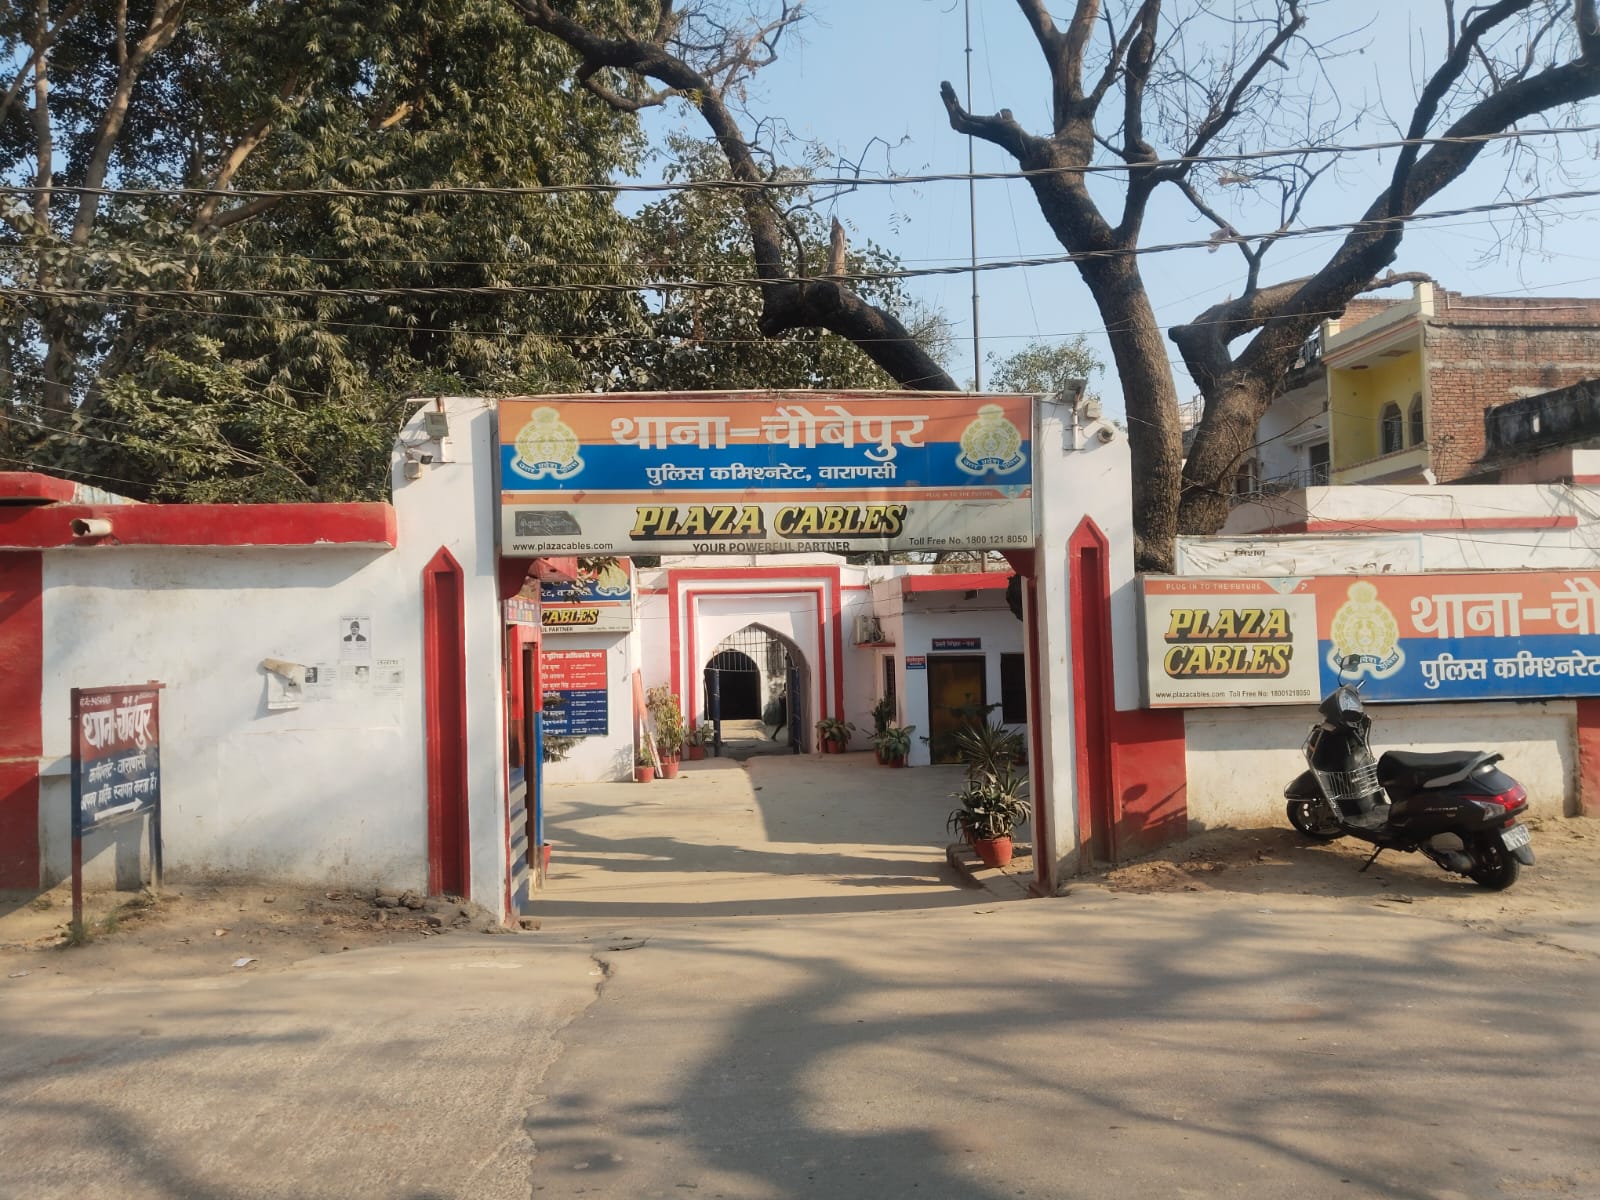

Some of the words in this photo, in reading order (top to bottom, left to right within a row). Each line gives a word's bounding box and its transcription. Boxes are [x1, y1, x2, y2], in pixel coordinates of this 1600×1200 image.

[646, 463, 704, 485] पुलिस
[709, 463, 812, 482] कमिश्नरेट,
[819, 462, 897, 480] वाराणसी
[629, 506, 767, 541] PLAZA
[774, 504, 907, 539] CABLES
[512, 541, 613, 552] www.plazacables.com
[693, 543, 726, 552] YOUR
[729, 542, 796, 552] POWERFUL
[798, 541, 850, 551] PARTNER
[909, 537, 924, 546] Toll
[927, 537, 946, 545] Free
[949, 536, 963, 545] No.
[967, 536, 986, 544] 1800
[990, 535, 1004, 544] 121
[1007, 535, 1028, 543] 8050
[1166, 583, 1187, 591] PLUG
[1189, 583, 1198, 591] IN
[1231, 583, 1262, 591] FUTURE
[541, 608, 599, 626] CABLES
[1164, 608, 1293, 644] PLAZA
[1164, 644, 1293, 680] CABLES
[1420, 653, 1488, 689] पुलिस
[1155, 690, 1226, 699] www.plazacables.com
